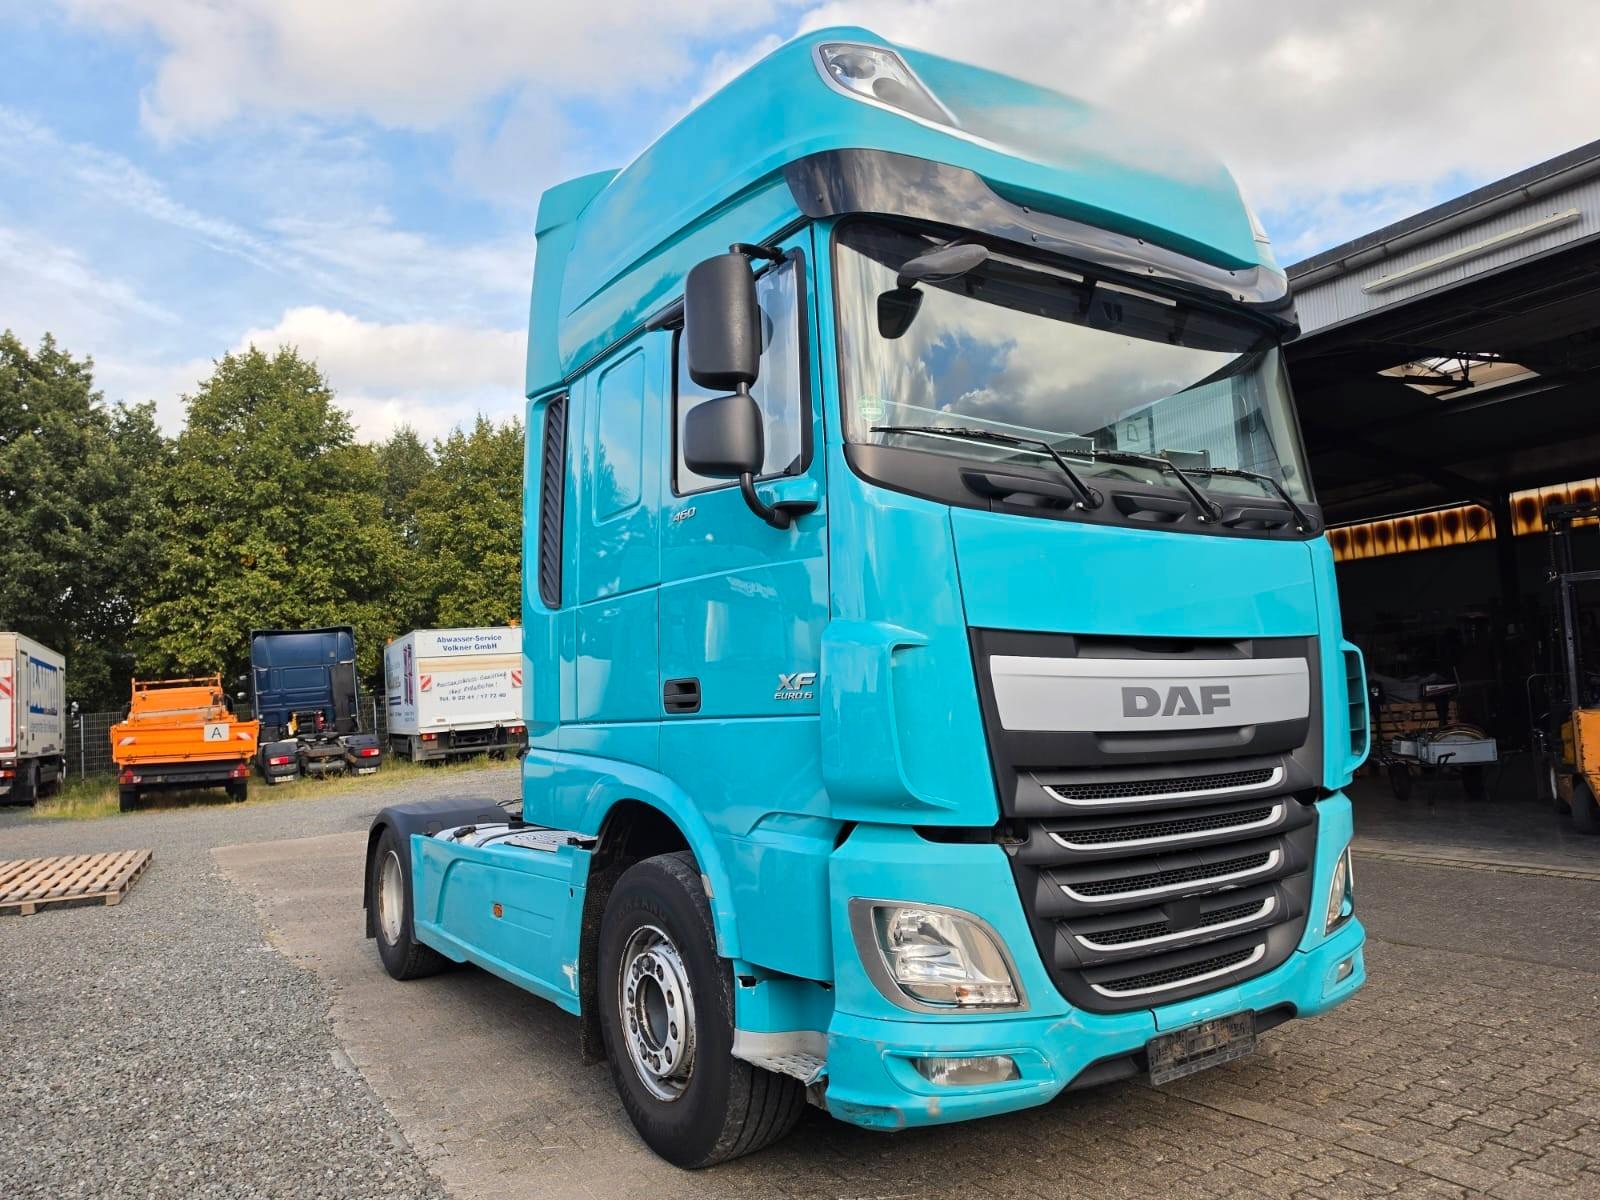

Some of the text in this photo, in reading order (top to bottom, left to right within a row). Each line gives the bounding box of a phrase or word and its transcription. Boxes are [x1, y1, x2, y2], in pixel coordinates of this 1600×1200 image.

[672, 506, 697, 522] 460
[436, 634, 502, 643] Abwasser-Service
[775, 672, 818, 690] XF
[774, 691, 814, 700] EURO 6
[1121, 685, 1231, 718] DAF
[211, 727, 222, 739] A
